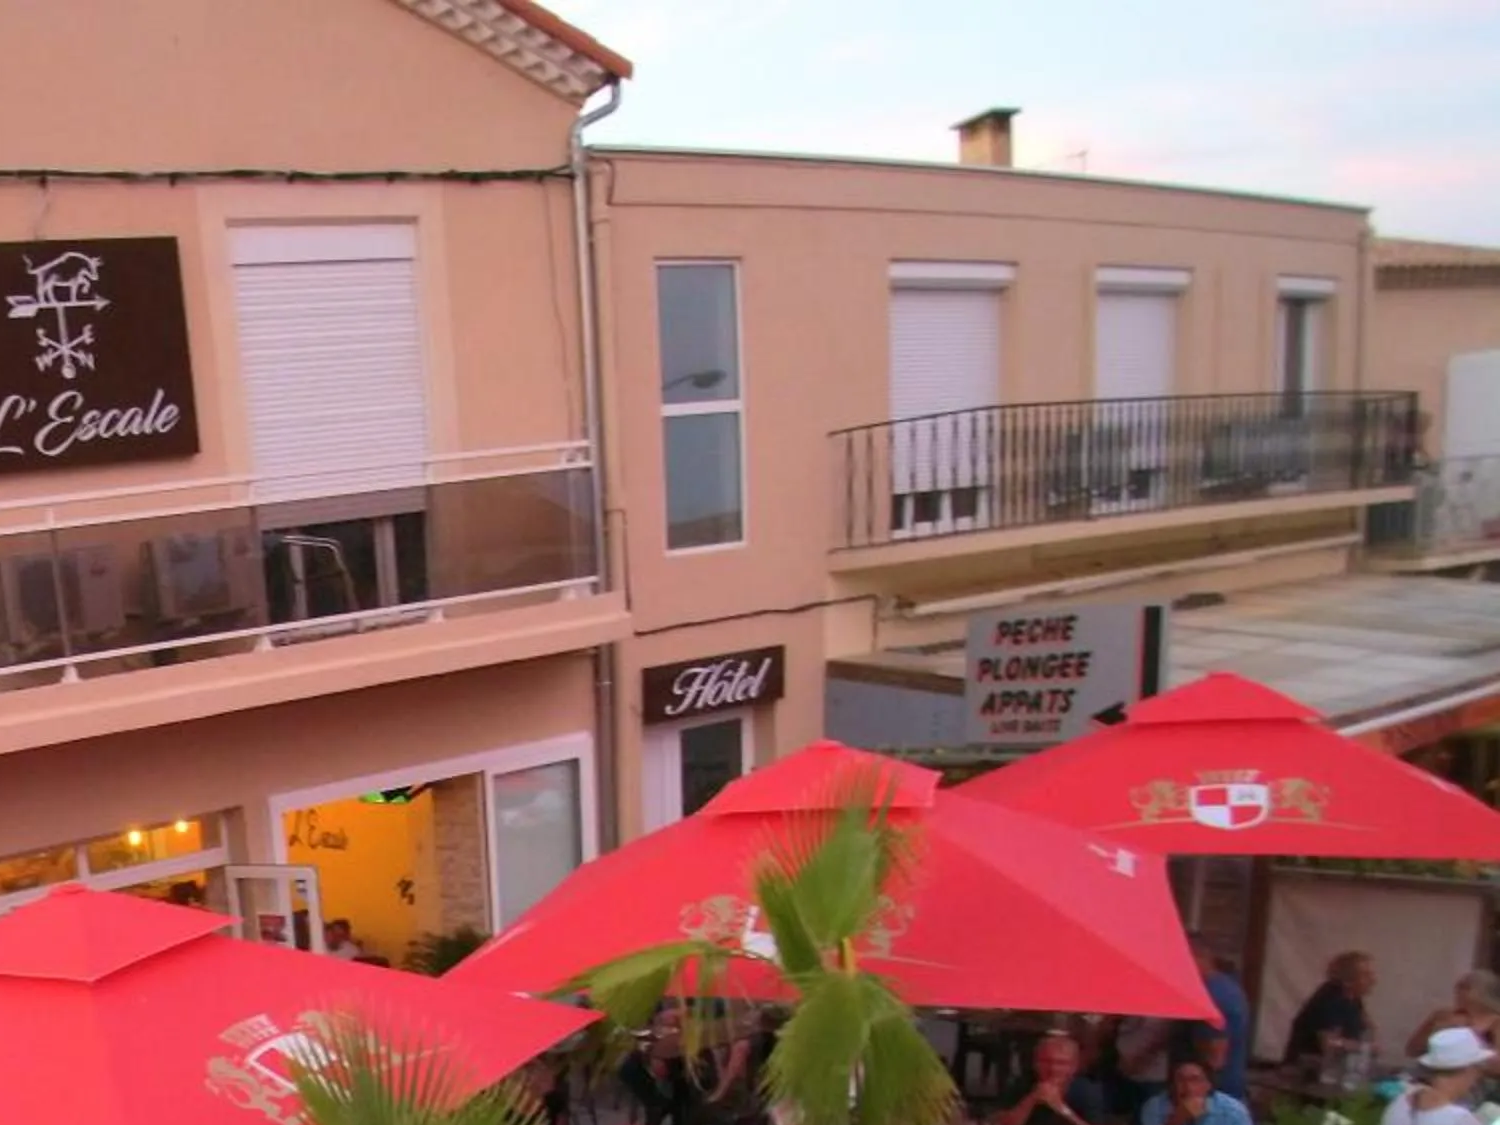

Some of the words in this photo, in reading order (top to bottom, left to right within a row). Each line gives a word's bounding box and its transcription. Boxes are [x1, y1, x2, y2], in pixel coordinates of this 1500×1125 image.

[994, 614, 1078, 646] PECHE
[977, 651, 1092, 683] PLONGEE
[979, 688, 1076, 716] APPATS
